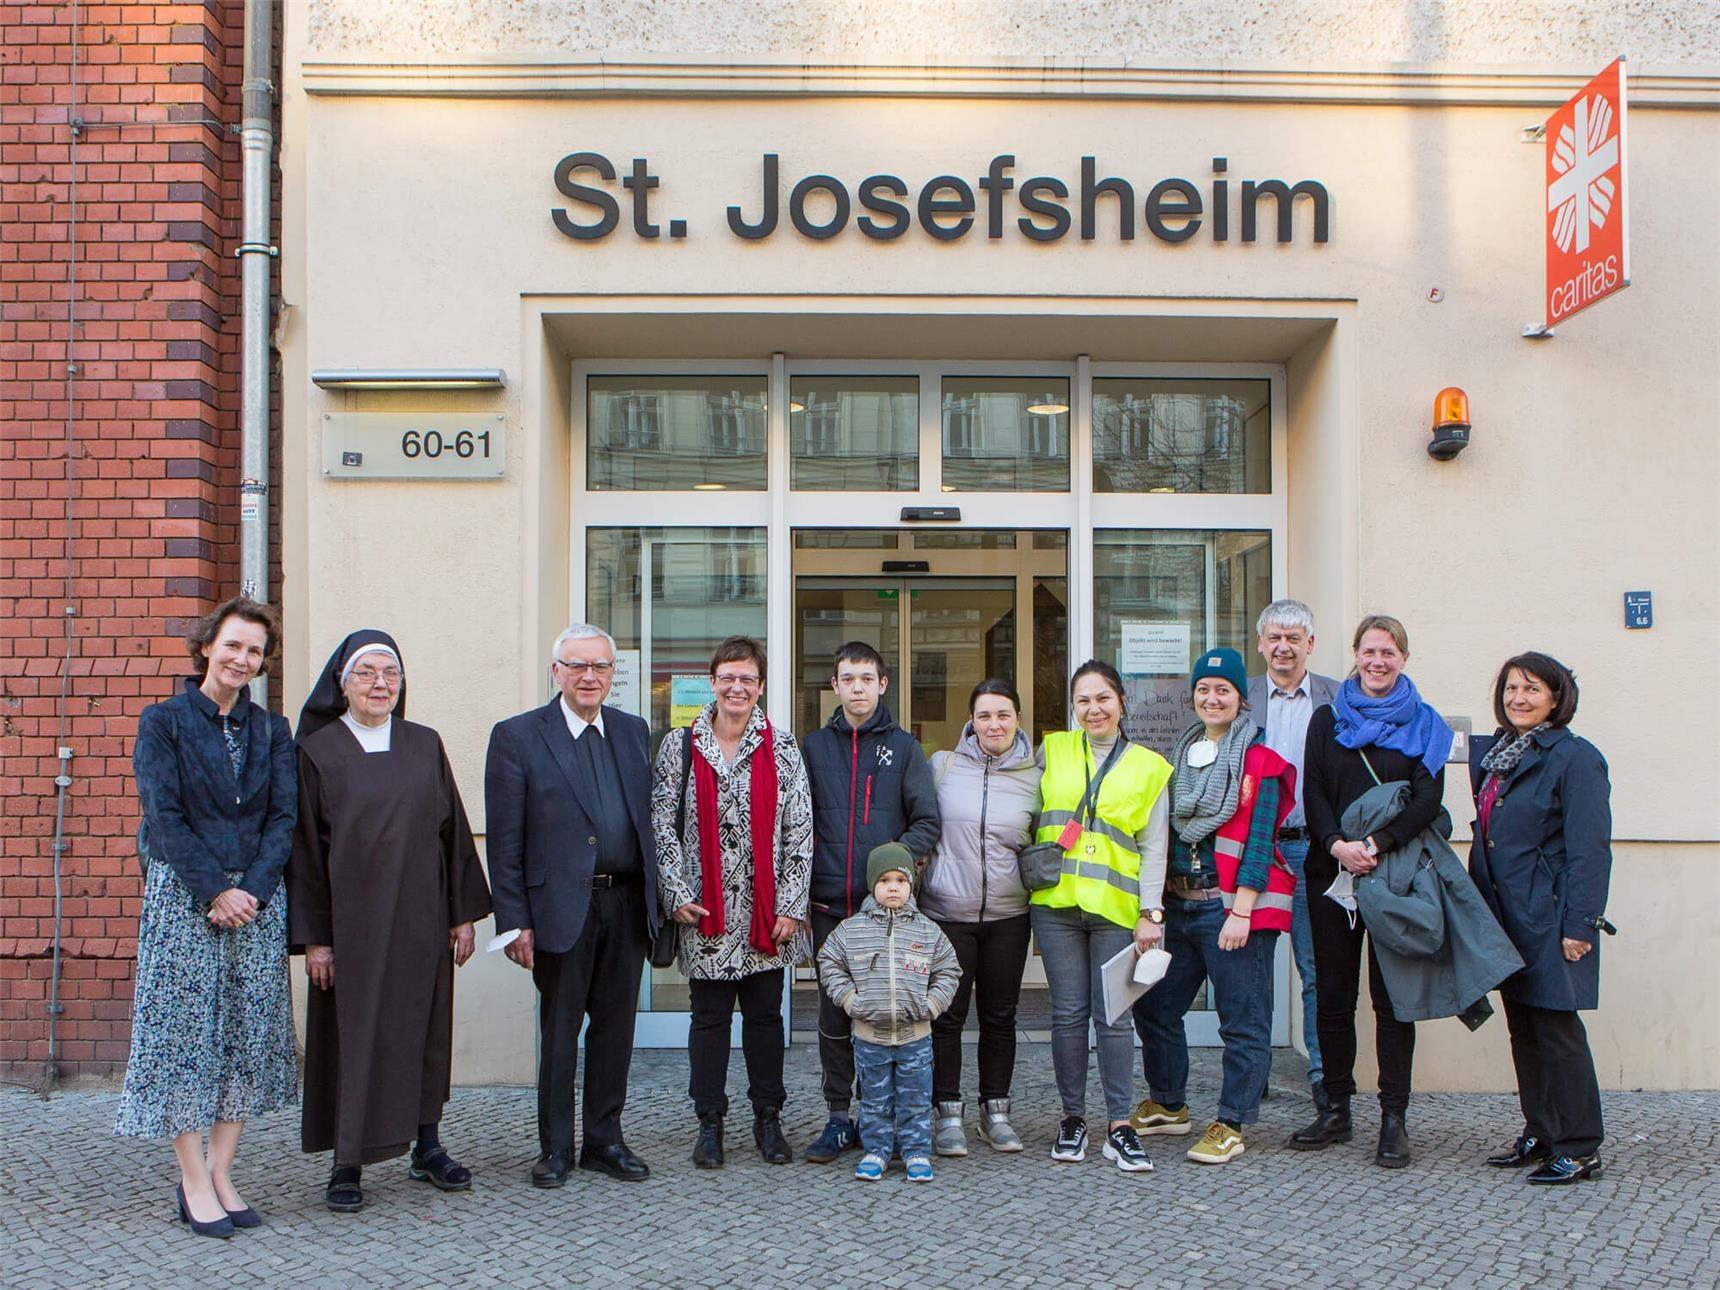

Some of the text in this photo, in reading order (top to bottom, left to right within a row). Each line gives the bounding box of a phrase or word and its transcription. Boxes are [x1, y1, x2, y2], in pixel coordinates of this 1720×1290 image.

[551, 152, 1329, 243] St. Josefsheim
[1551, 254, 1618, 319] caritas
[401, 430, 490, 459] 60-61
